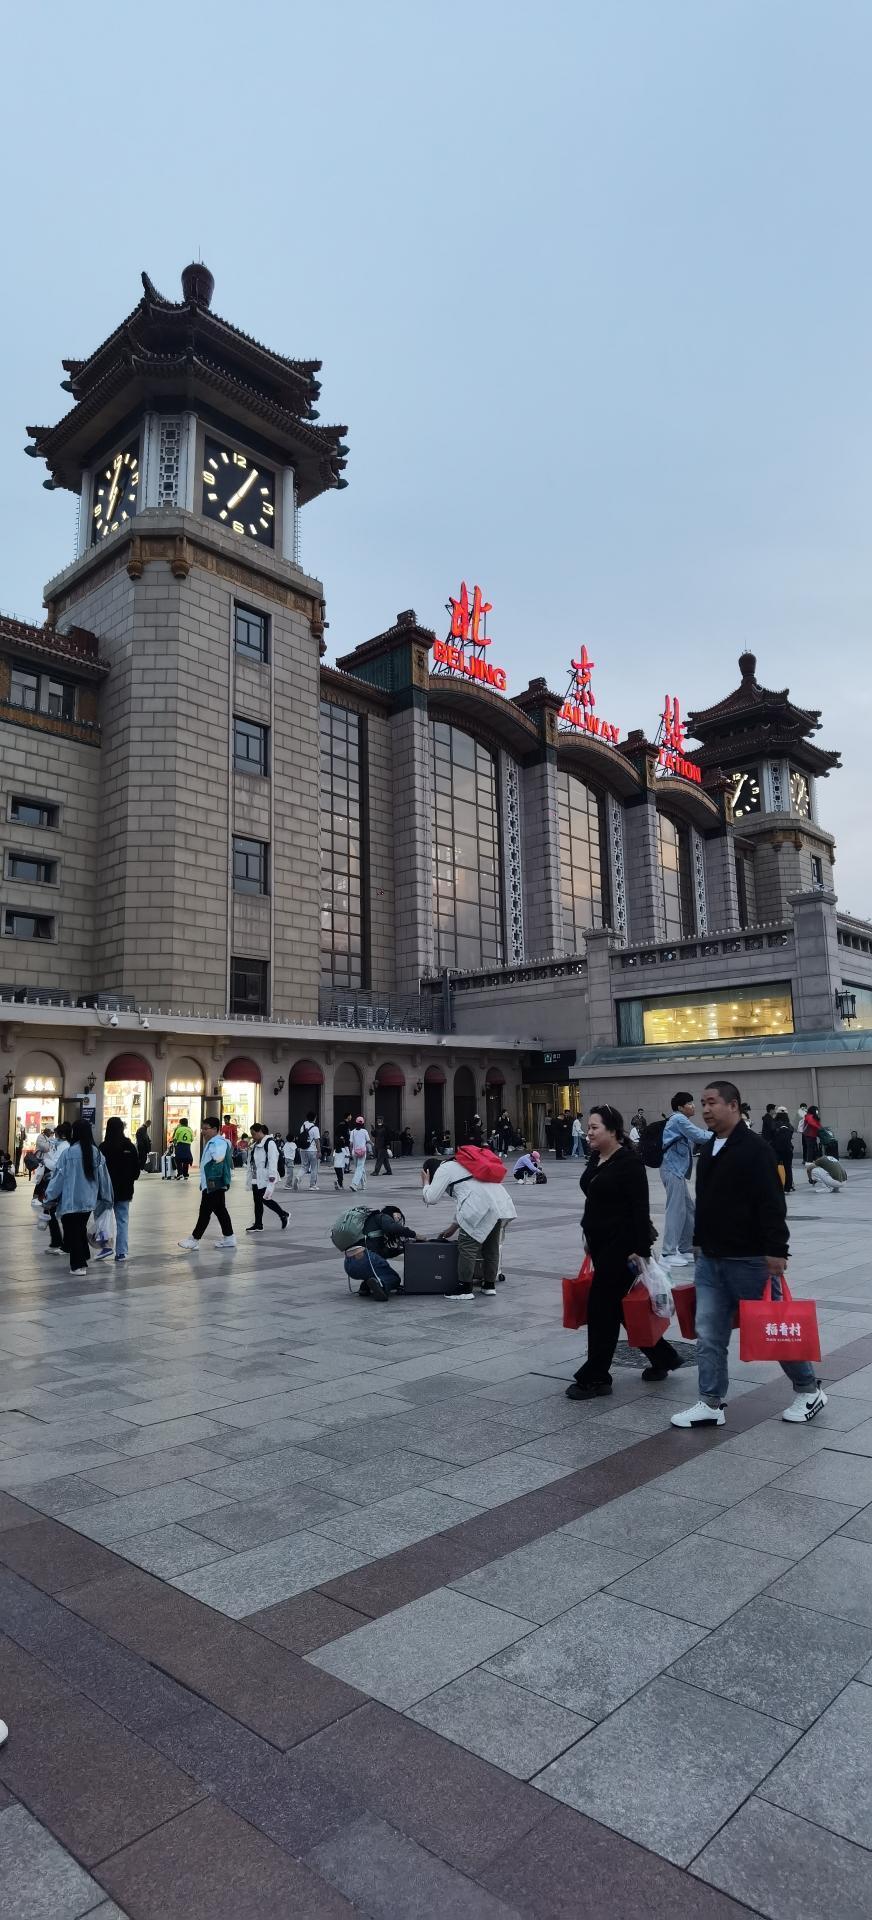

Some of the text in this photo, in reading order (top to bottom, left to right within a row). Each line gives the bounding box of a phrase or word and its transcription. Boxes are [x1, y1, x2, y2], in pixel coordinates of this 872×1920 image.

[233, 452, 247, 469] 12
[202, 470, 216, 486] 9
[94, 503, 102, 518] 9
[262, 501, 274, 516] 3
[232, 520, 245, 535] 6
[448, 581, 687, 755] 北 京 站
[433, 639, 507, 691] BEIJING
[657, 748, 702, 784] TATION
[182, 1132, 188, 1142] 6
